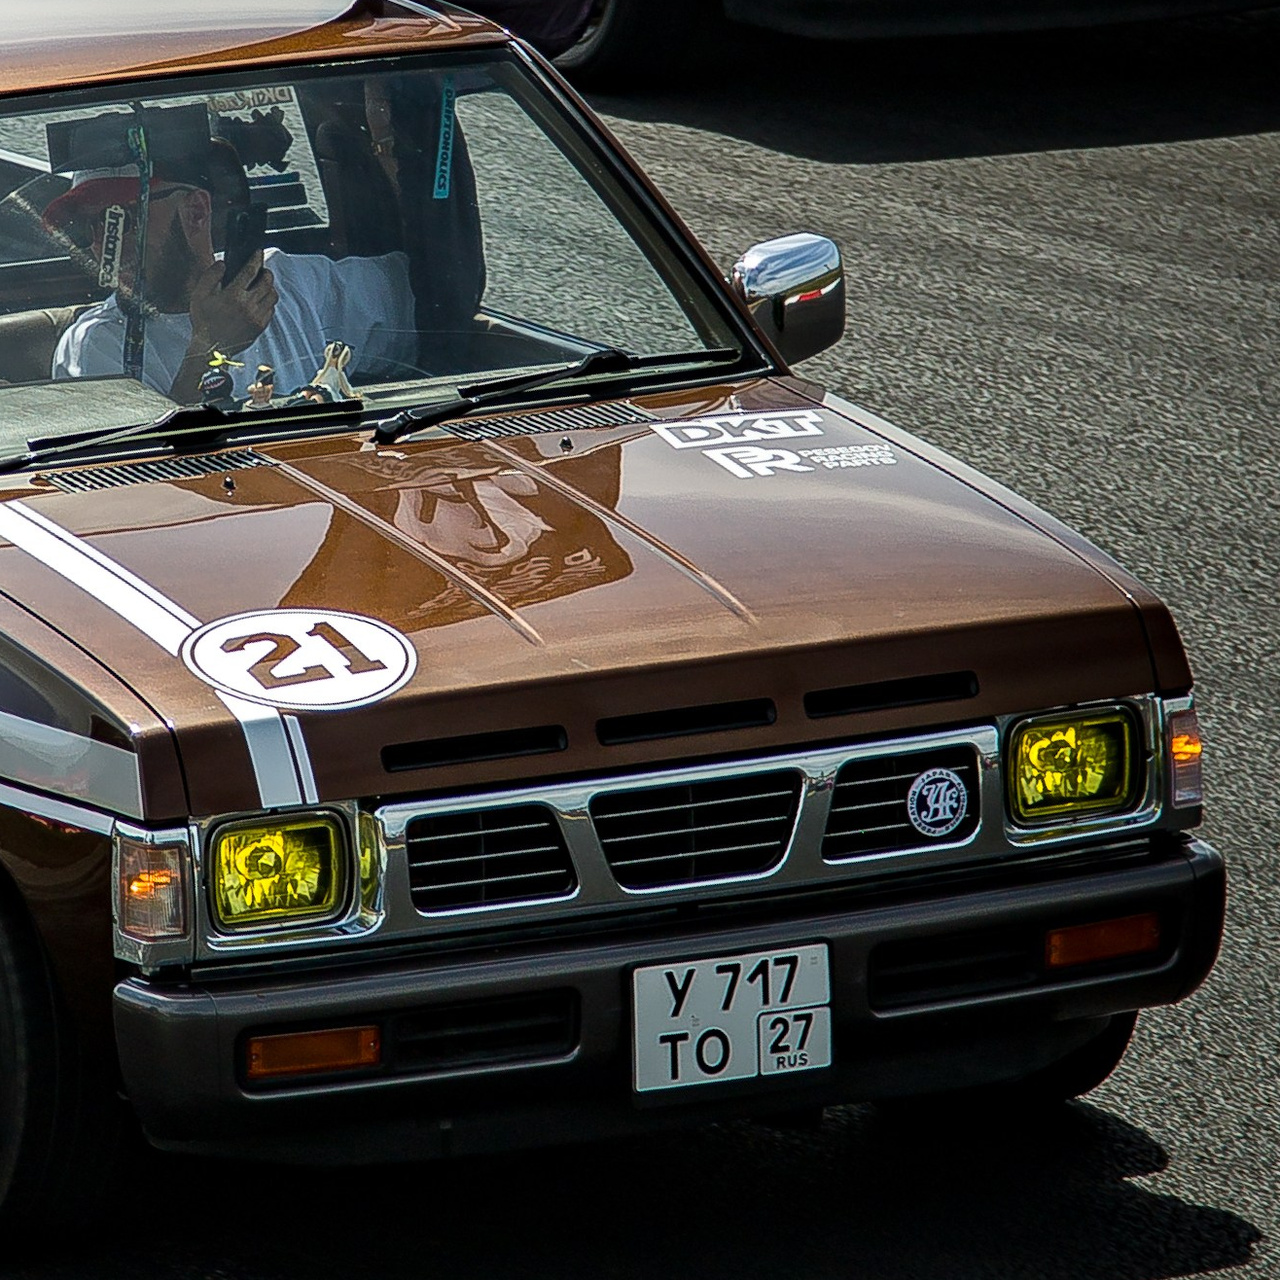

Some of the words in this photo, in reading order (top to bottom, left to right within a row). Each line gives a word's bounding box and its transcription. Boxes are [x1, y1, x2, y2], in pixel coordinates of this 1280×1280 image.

[436, 87, 455, 192] DRIFTOHOLICS
[648, 409, 824, 449] DKT
[821, 458, 898, 470] PARTS
[220, 621, 388, 690] 21
[716, 955, 799, 1011] 717
[769, 1013, 814, 1054] 27
[776, 1053, 808, 1069] RUS
